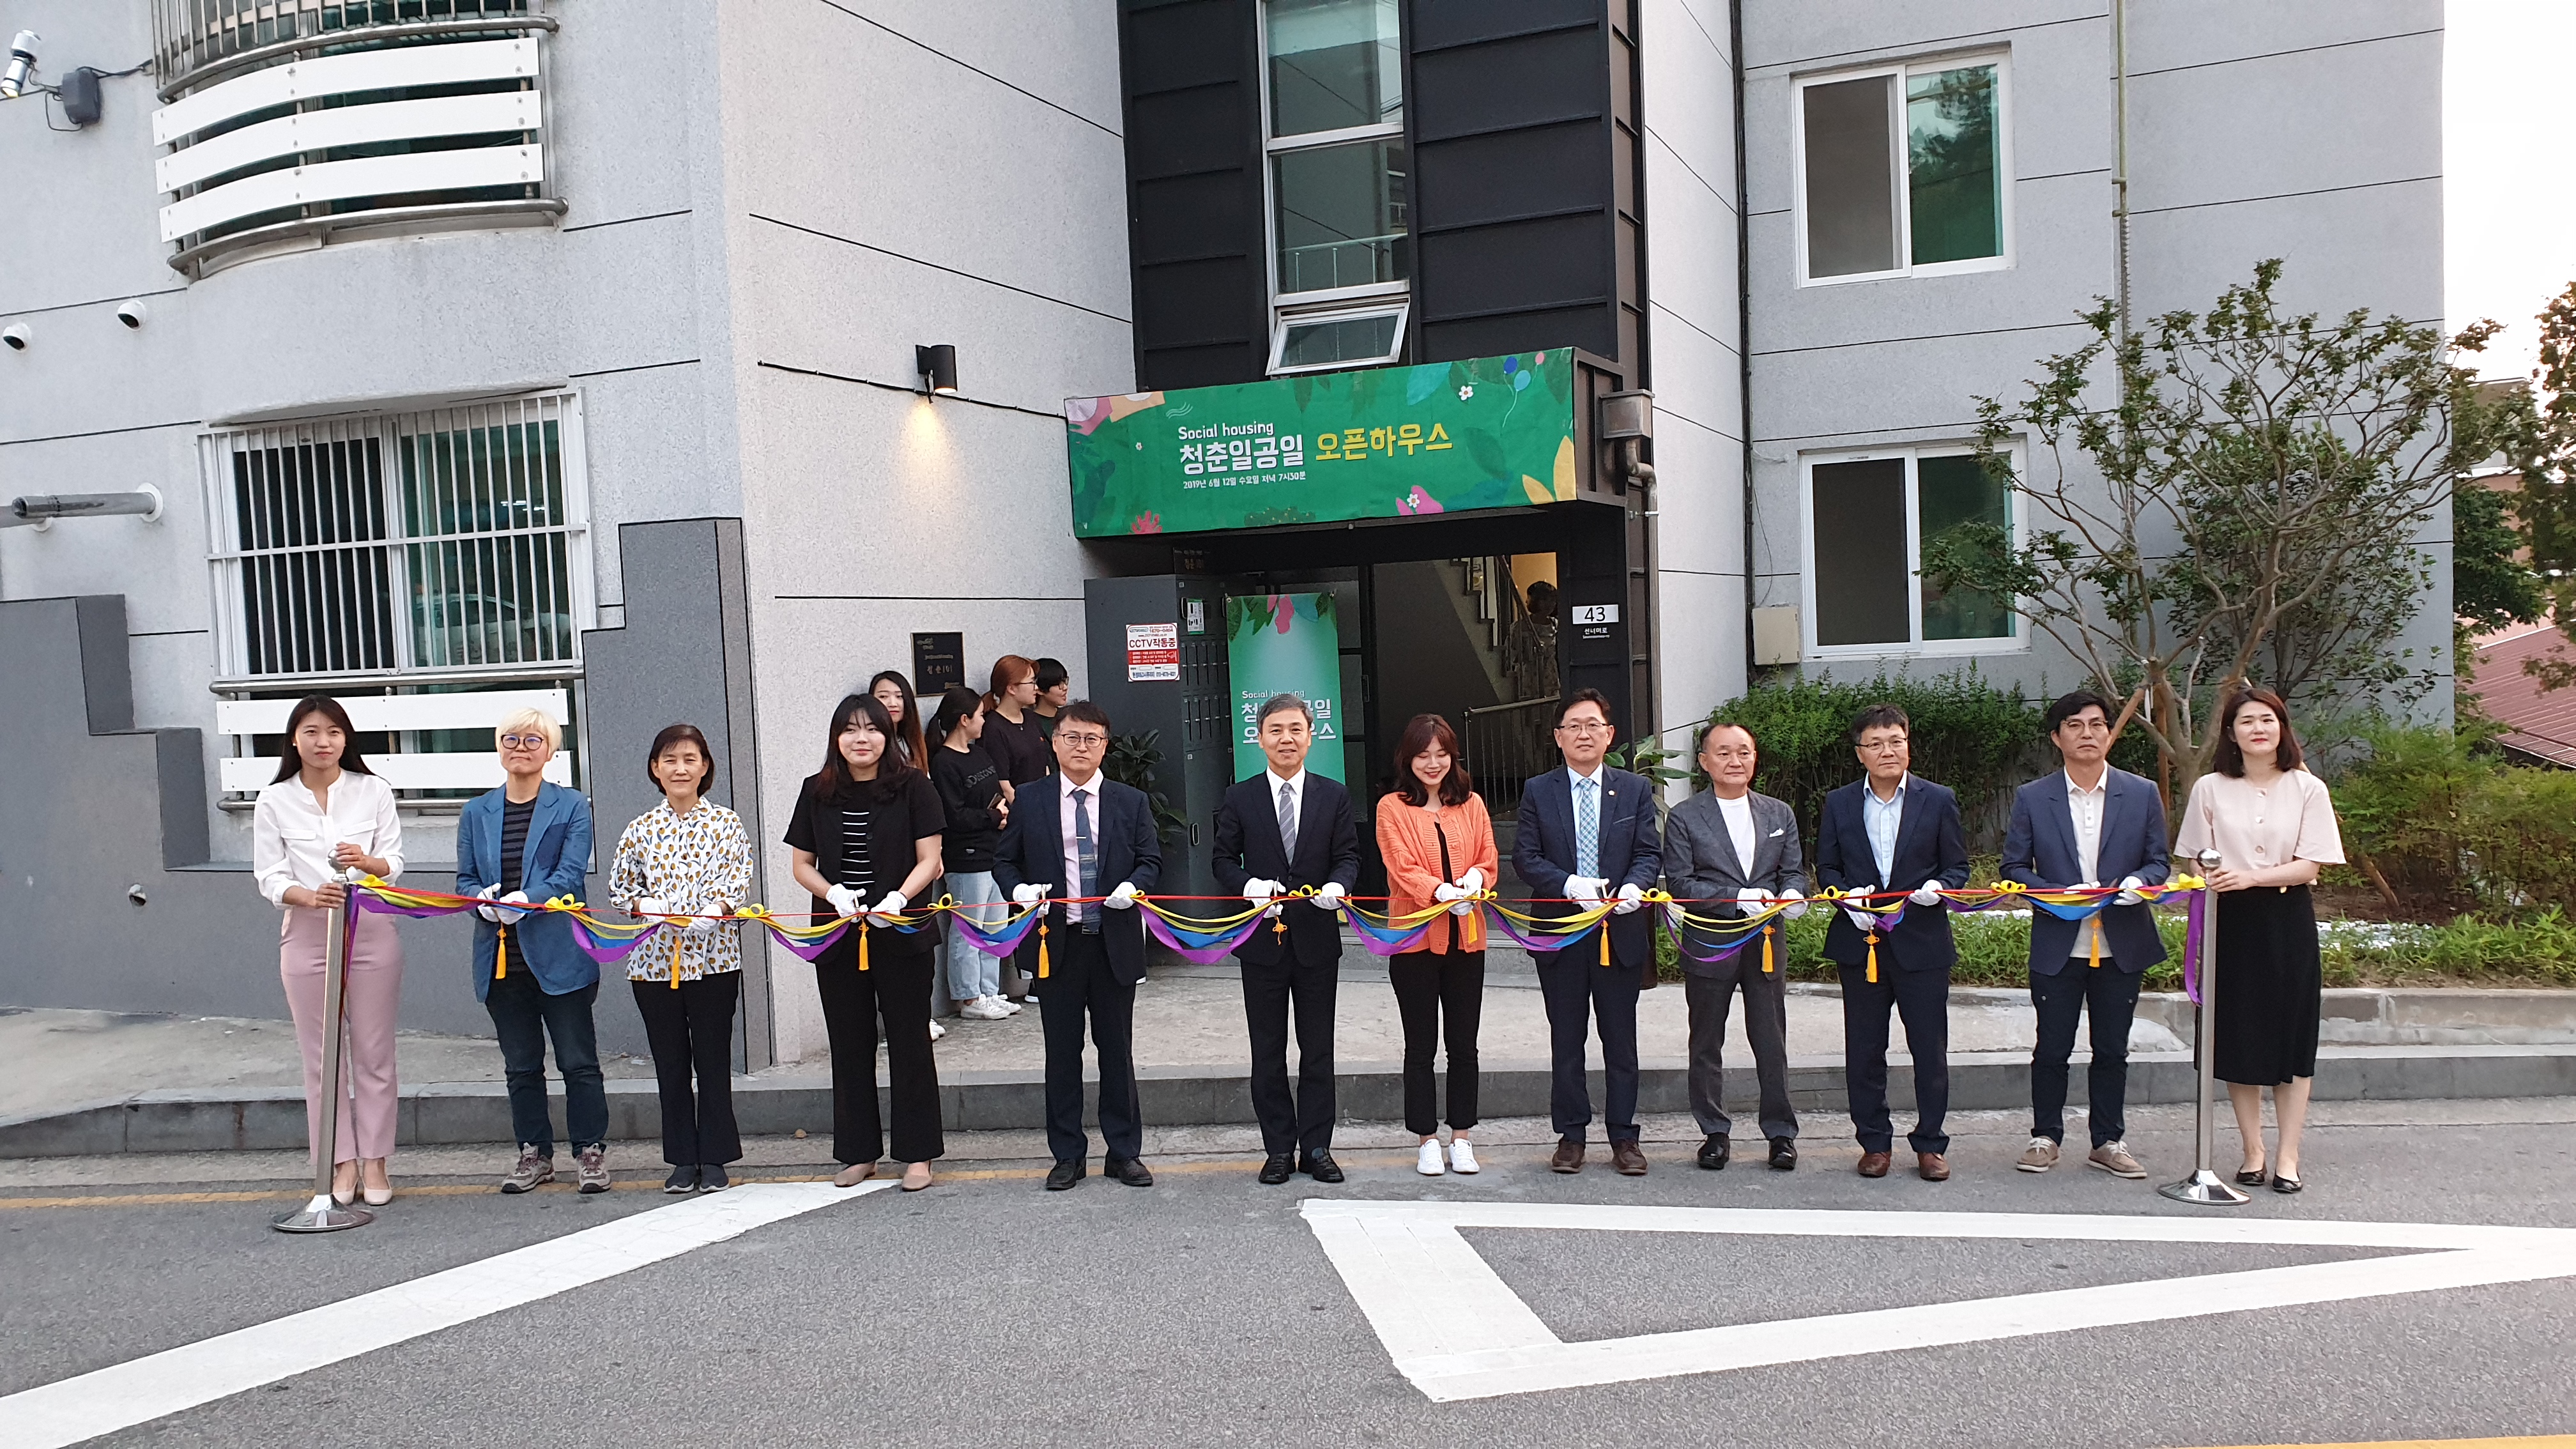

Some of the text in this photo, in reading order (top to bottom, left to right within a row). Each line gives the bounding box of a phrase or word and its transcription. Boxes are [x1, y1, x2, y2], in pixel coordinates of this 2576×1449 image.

[1178, 421, 1274, 440] Social housing
[1179, 423, 1453, 475] 청춘일공일 오픈하우스
[1183, 471, 1306, 489] 2019년 6월 12일 수요일 저녁 7시30분
[1584, 607, 1606, 622] 43
[1129, 638, 1176, 648] CCTV작동중
[1242, 690, 1268, 698] Social
